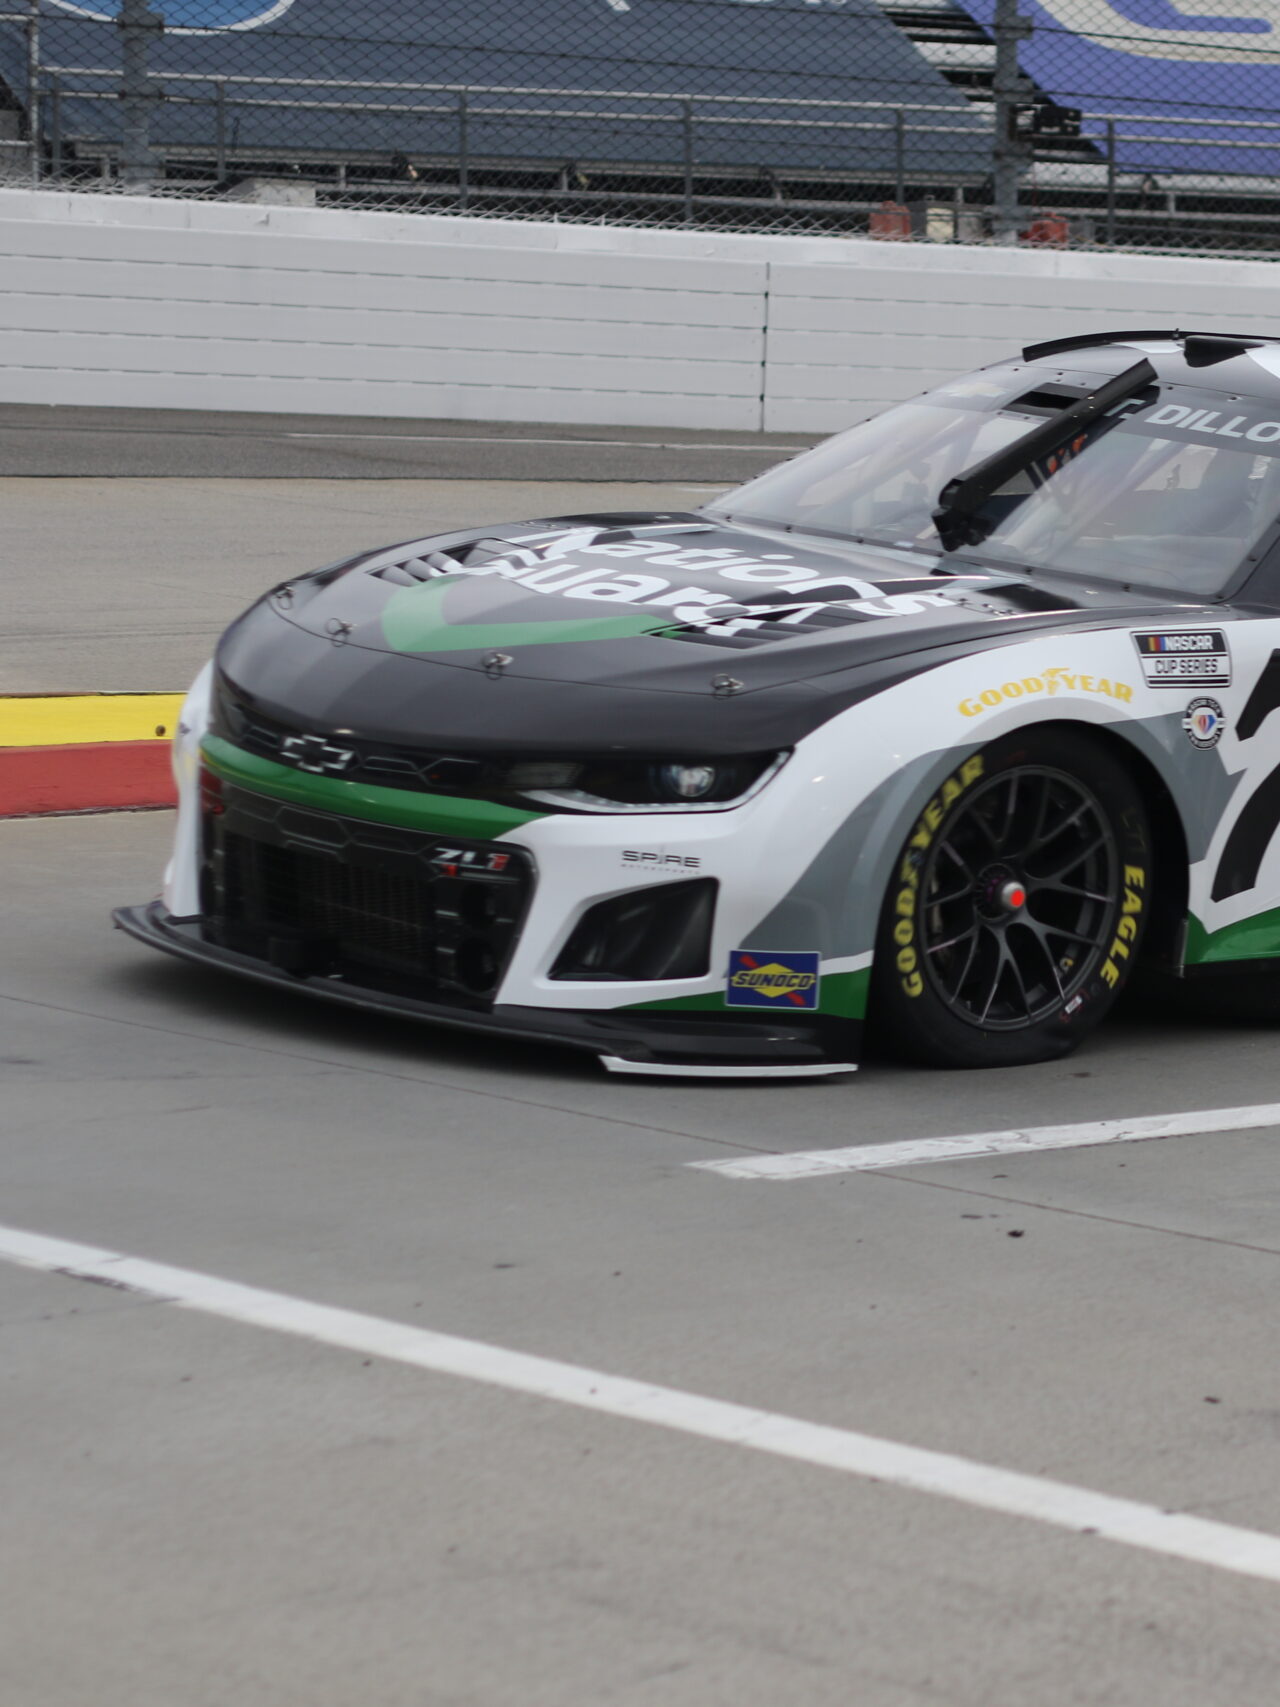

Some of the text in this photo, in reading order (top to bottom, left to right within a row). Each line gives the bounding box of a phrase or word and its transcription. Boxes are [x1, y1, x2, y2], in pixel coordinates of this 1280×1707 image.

[1165, 634, 1214, 651] NASCAR
[1155, 658, 1218, 674] CUP SERIES
[1100, 864, 1145, 989] EAGLE
[735, 972, 814, 989] SUNOCO
